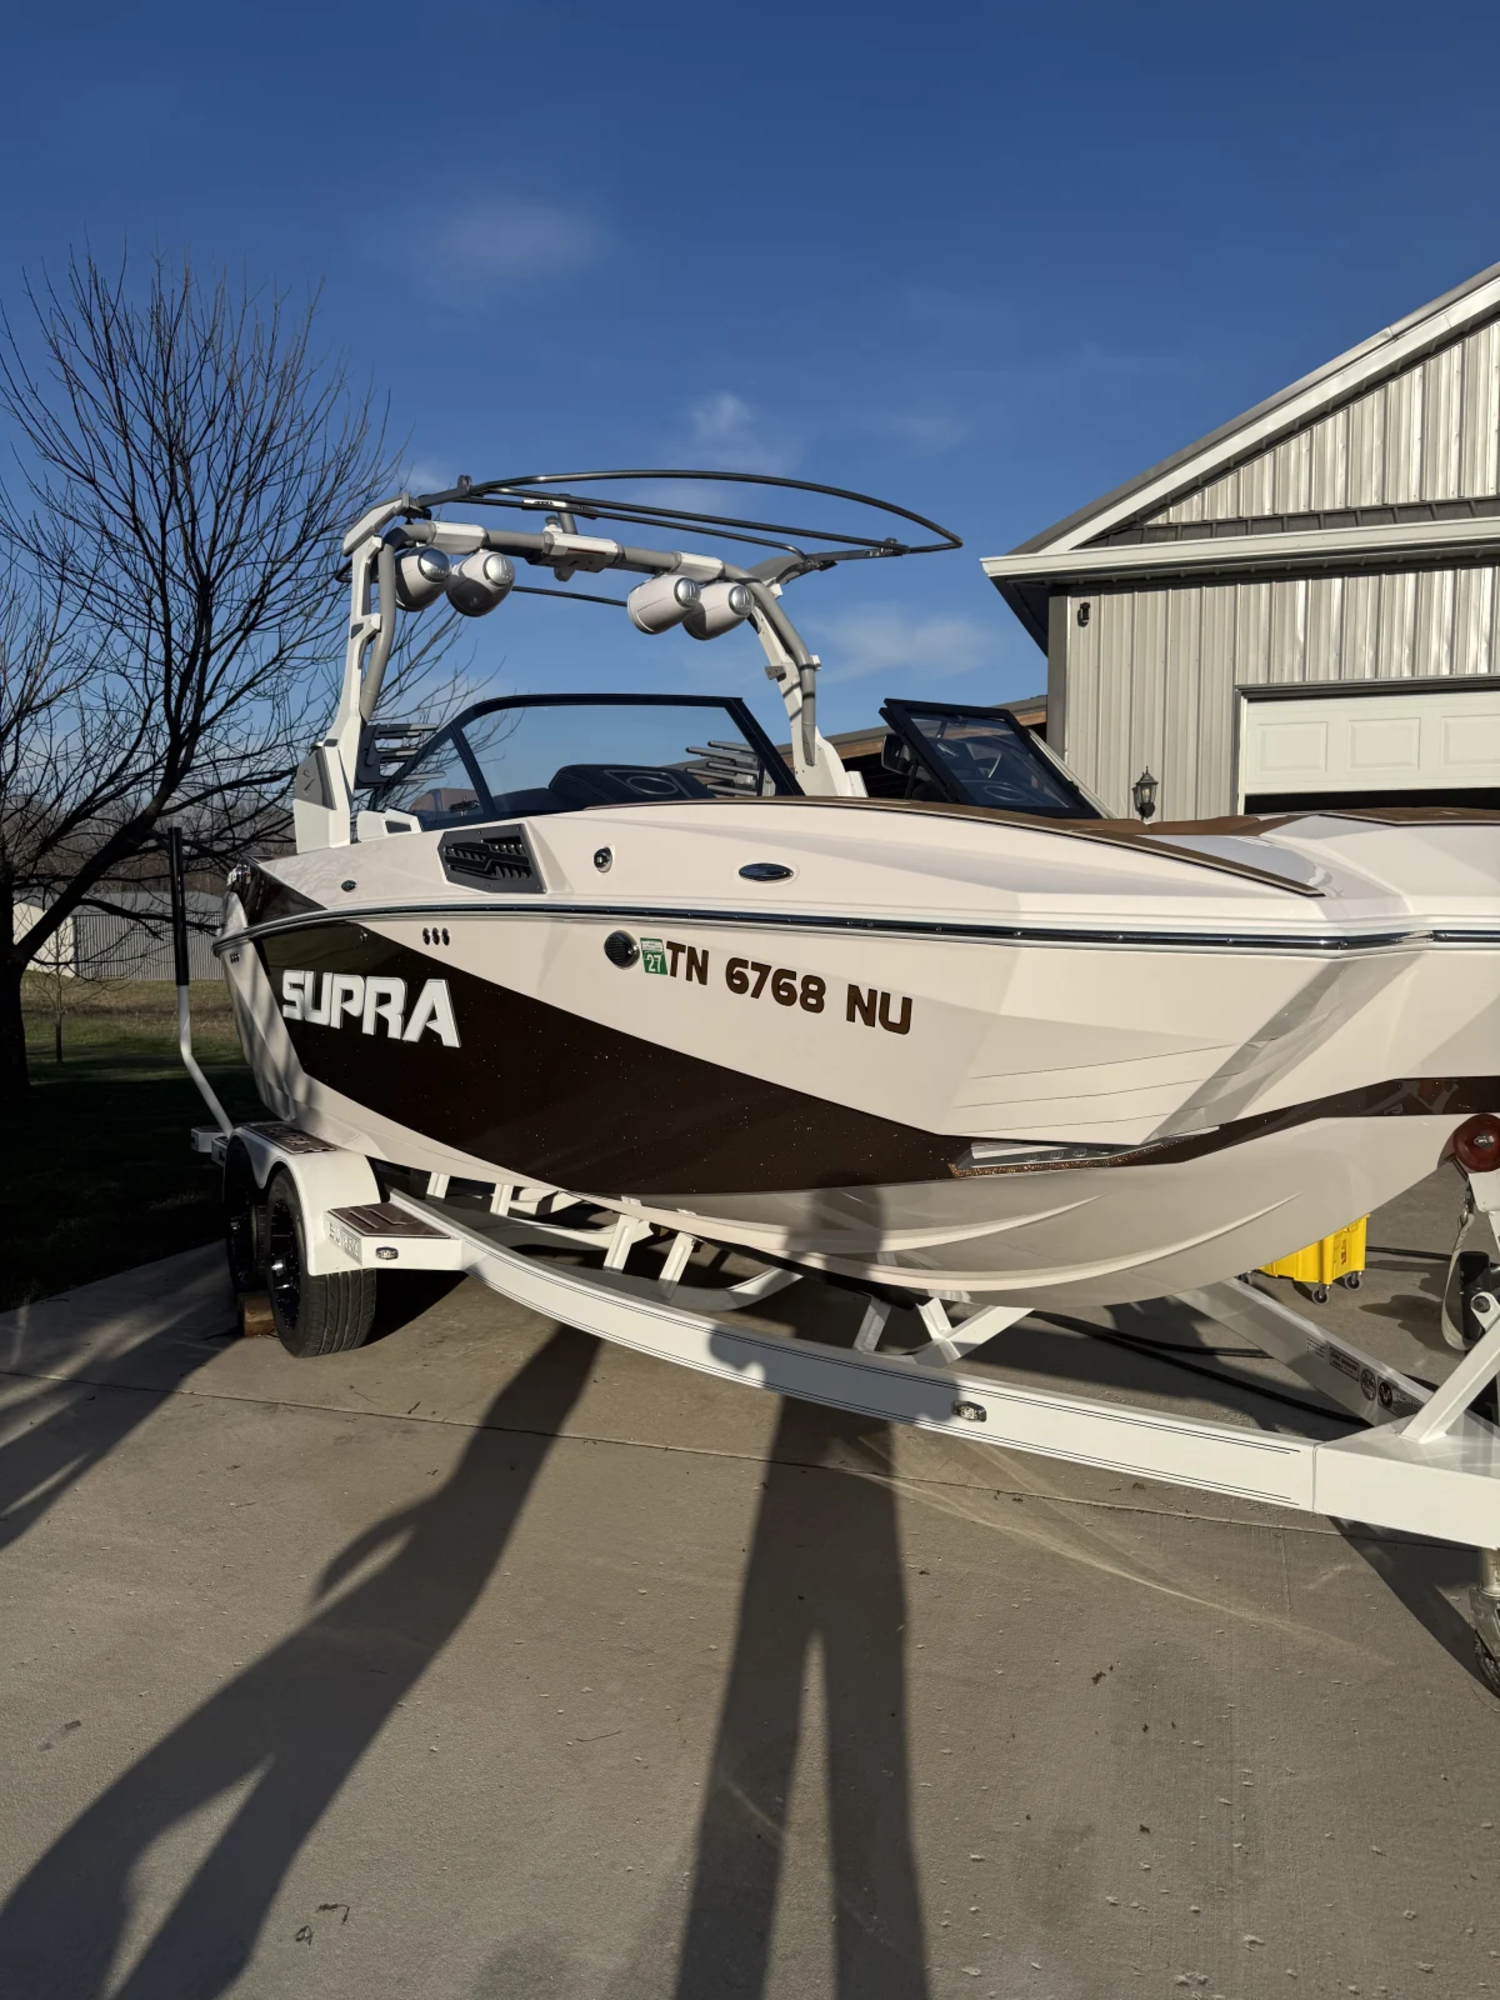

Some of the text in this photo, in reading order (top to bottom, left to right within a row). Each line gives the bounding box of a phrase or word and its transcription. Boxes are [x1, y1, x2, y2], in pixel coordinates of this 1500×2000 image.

[647, 953, 662, 973] 27
[666, 941, 913, 1035] TN 6768 NU
[283, 970, 461, 1048] SUPRA
